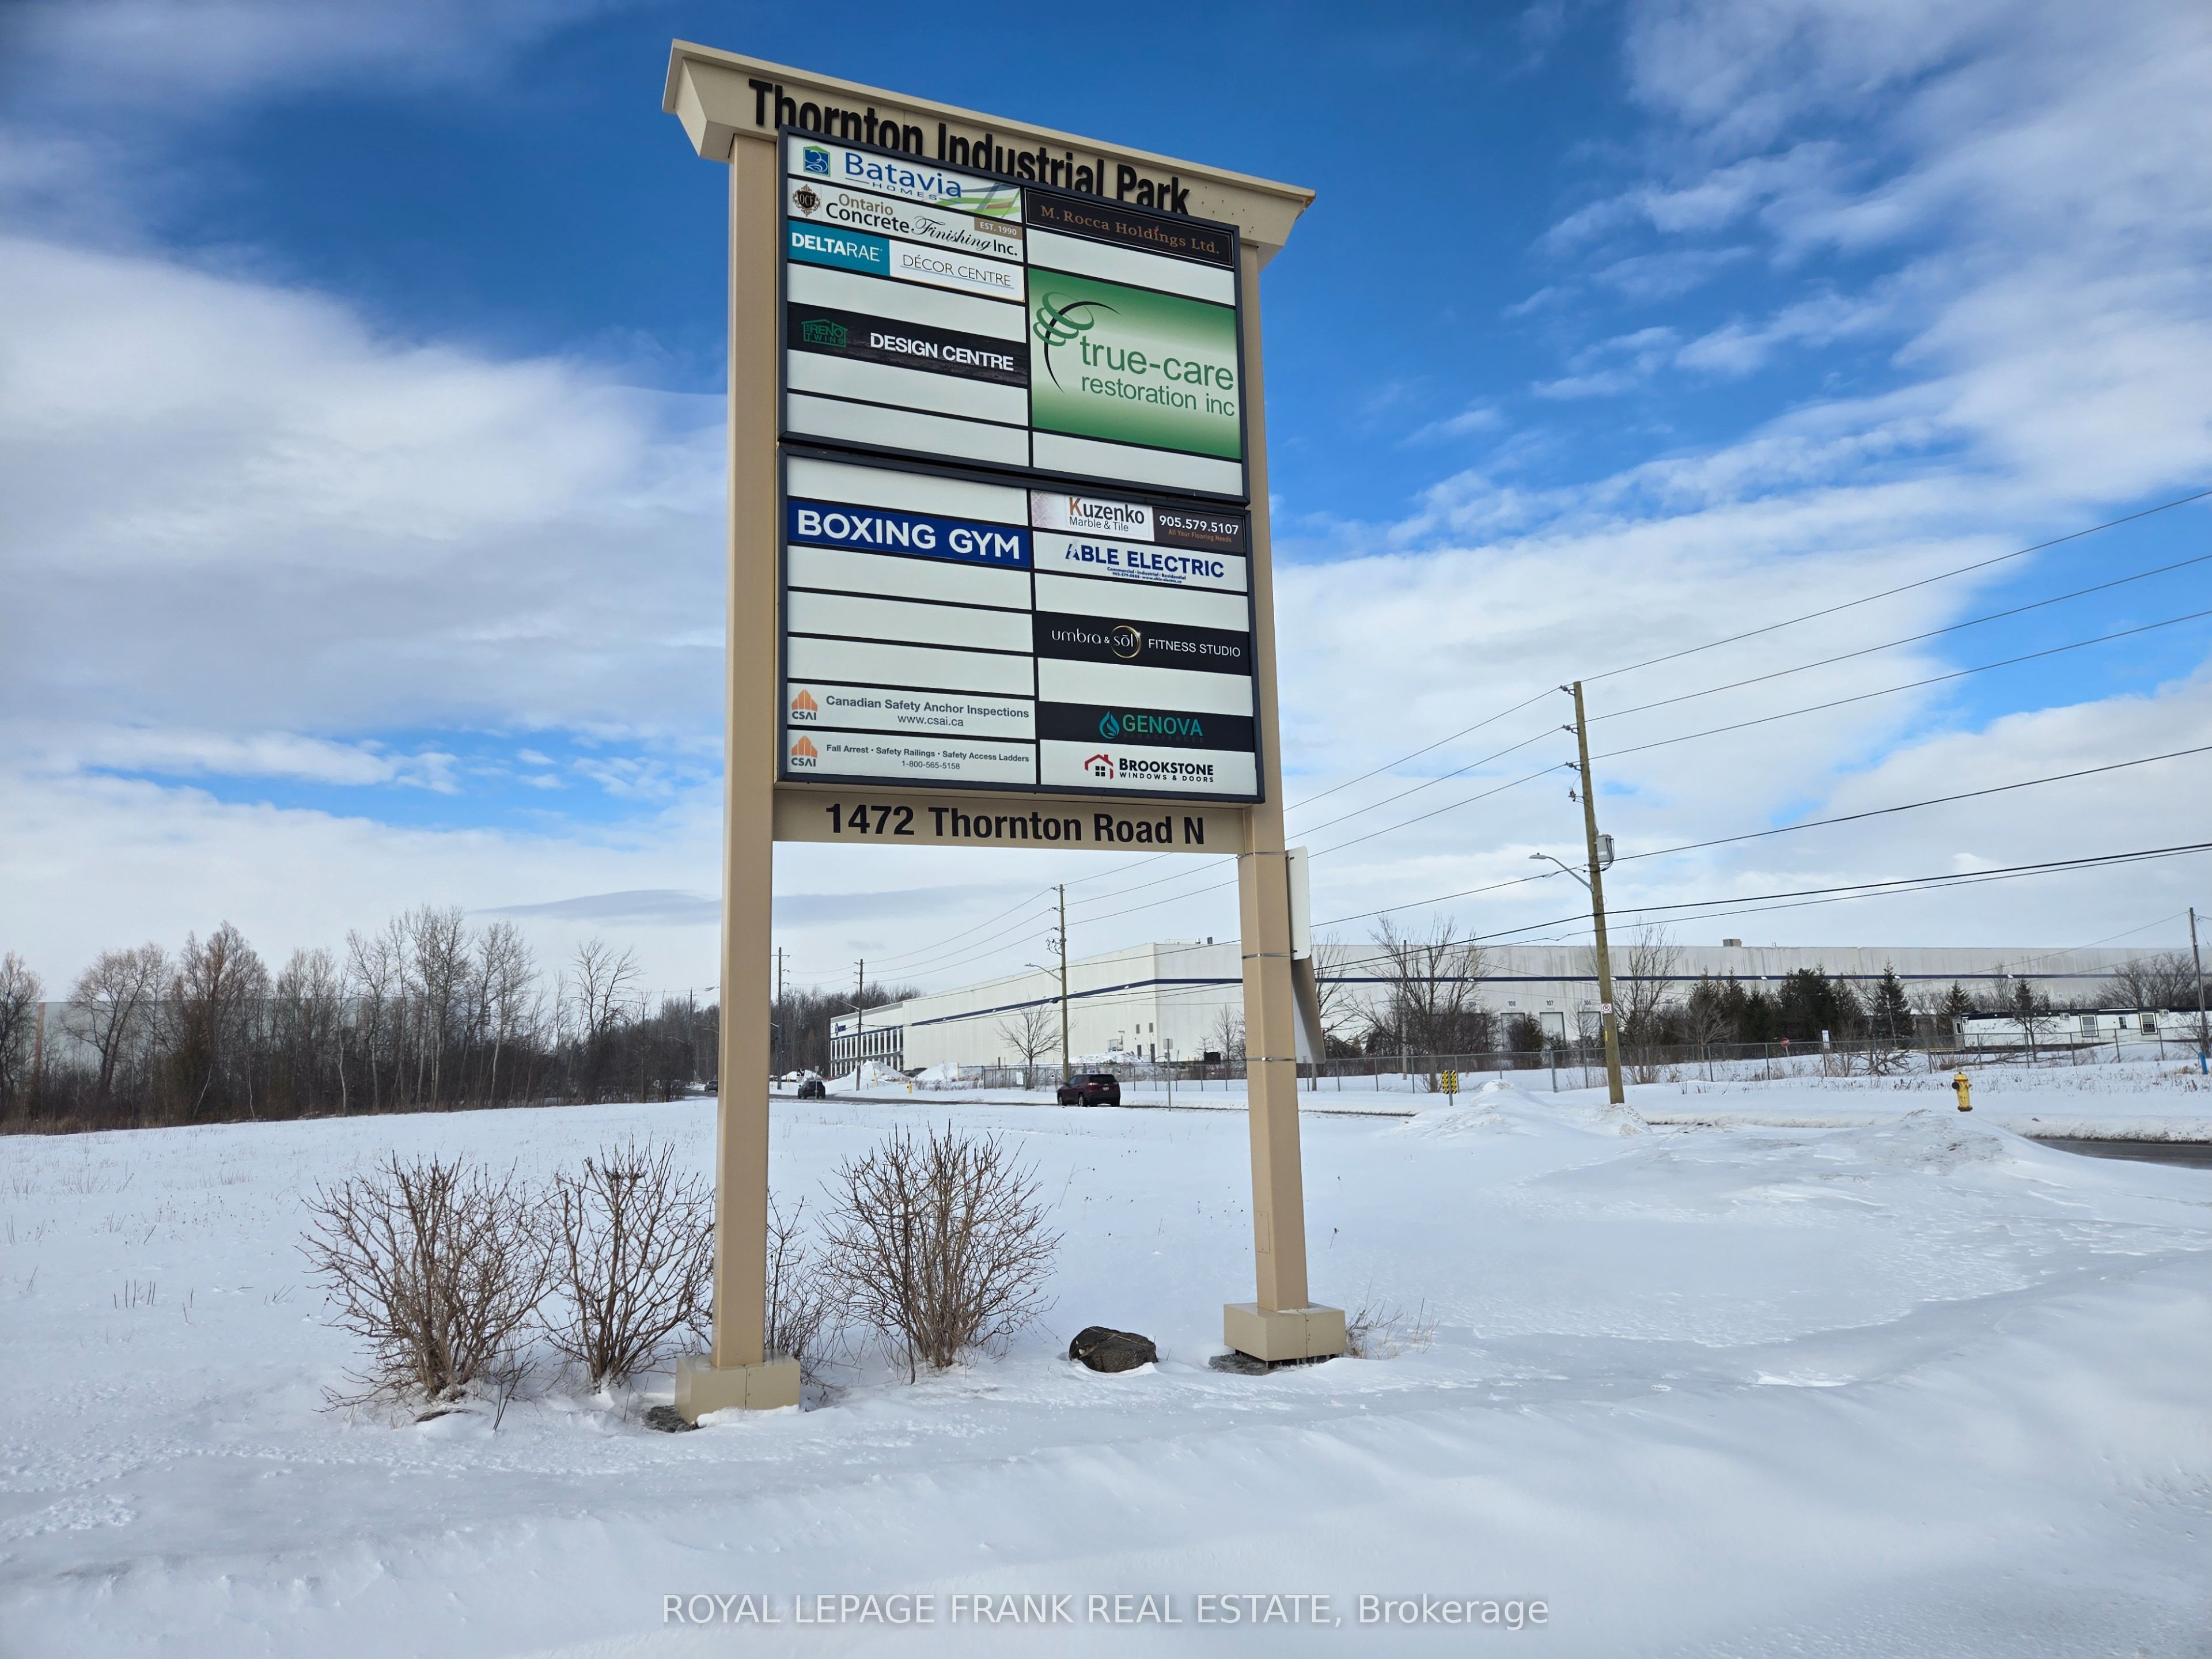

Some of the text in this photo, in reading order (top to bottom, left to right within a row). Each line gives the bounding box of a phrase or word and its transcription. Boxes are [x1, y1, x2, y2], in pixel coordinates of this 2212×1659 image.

[748, 78, 1190, 216] Thornton Industrial Park
[845, 151, 962, 198] Batavia
[800, 194, 813, 206] OCF
[872, 183, 938, 200] HOMES
[838, 193, 893, 216] Ontario
[825, 202, 1018, 256] Concrete Finishing Inc.
[980, 221, 1017, 236] EST. 1990
[1040, 205, 1220, 254] M. Rocca Holdings Ltd.
[903, 253, 1011, 286] DÉCOR CENTRE
[806, 333, 844, 344] TWINS
[810, 323, 843, 338] RENO
[870, 332, 1014, 372] DESIGN CENTRE
[1080, 335, 1234, 391] true-care
[1081, 374, 1235, 416] restoration inc
[1069, 497, 1145, 524] Kuzenko
[798, 509, 1020, 560] BOXING GYM
[1069, 516, 1129, 532] Marble & Tile
[1159, 515, 1239, 535] 905.579.5107
[1191, 532, 1214, 542] Flooring
[1215, 535, 1232, 543] Needs
[1065, 543, 1225, 578] ABLE ELECTRIC
[1051, 628, 1101, 645] umbra
[1104, 636, 1110, 644] &
[1148, 638, 1196, 653] FITNESS
[1199, 643, 1241, 657] STUDIO
[825, 695, 881, 709] Canadian
[885, 699, 921, 713] Safety
[923, 702, 964, 714] Anchor
[967, 704, 1029, 719] Inspections
[897, 714, 964, 727] www.csai.ca
[1122, 714, 1203, 737] GENOVA
[826, 744, 842, 752] Fall
[843, 745, 869, 754] Arrest
[876, 747, 902, 757] Safety
[903, 748, 935, 758] Railings
[942, 751, 967, 760] Safety
[969, 752, 997, 761] Access
[998, 753, 1029, 763] Ladders
[902, 760, 960, 770] 1-800-565-5158
[1119, 757, 1214, 776] BROOKSTONE
[1119, 772, 1167, 780] WINDOWS
[825, 803, 1205, 845] 1472 Thornton Road N
